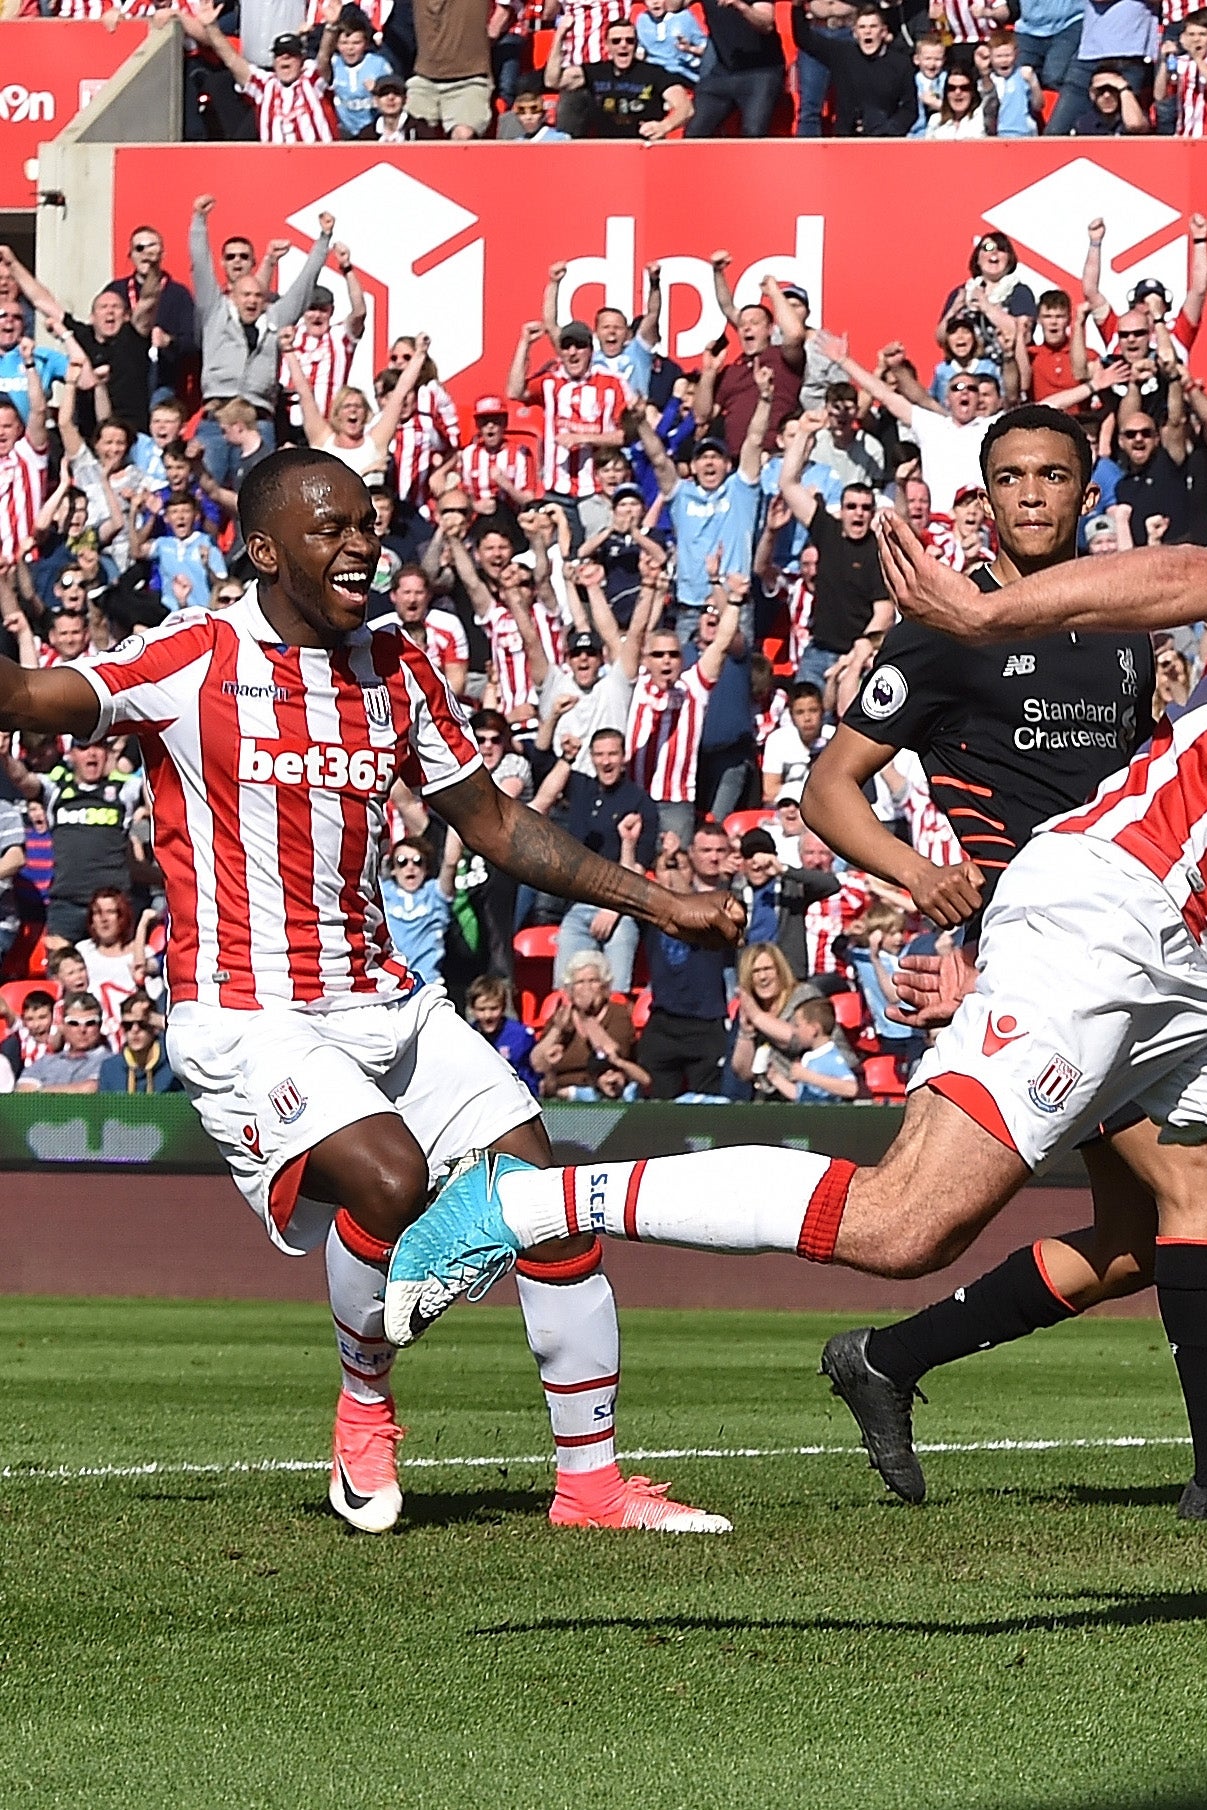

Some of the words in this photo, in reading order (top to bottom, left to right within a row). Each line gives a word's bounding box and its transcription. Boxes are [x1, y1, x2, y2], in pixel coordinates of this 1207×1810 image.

[553, 214, 826, 359] dpd
[1023, 698, 1117, 724] Standard
[1013, 726, 1118, 750] Chartered
[237, 737, 396, 792] bet365
